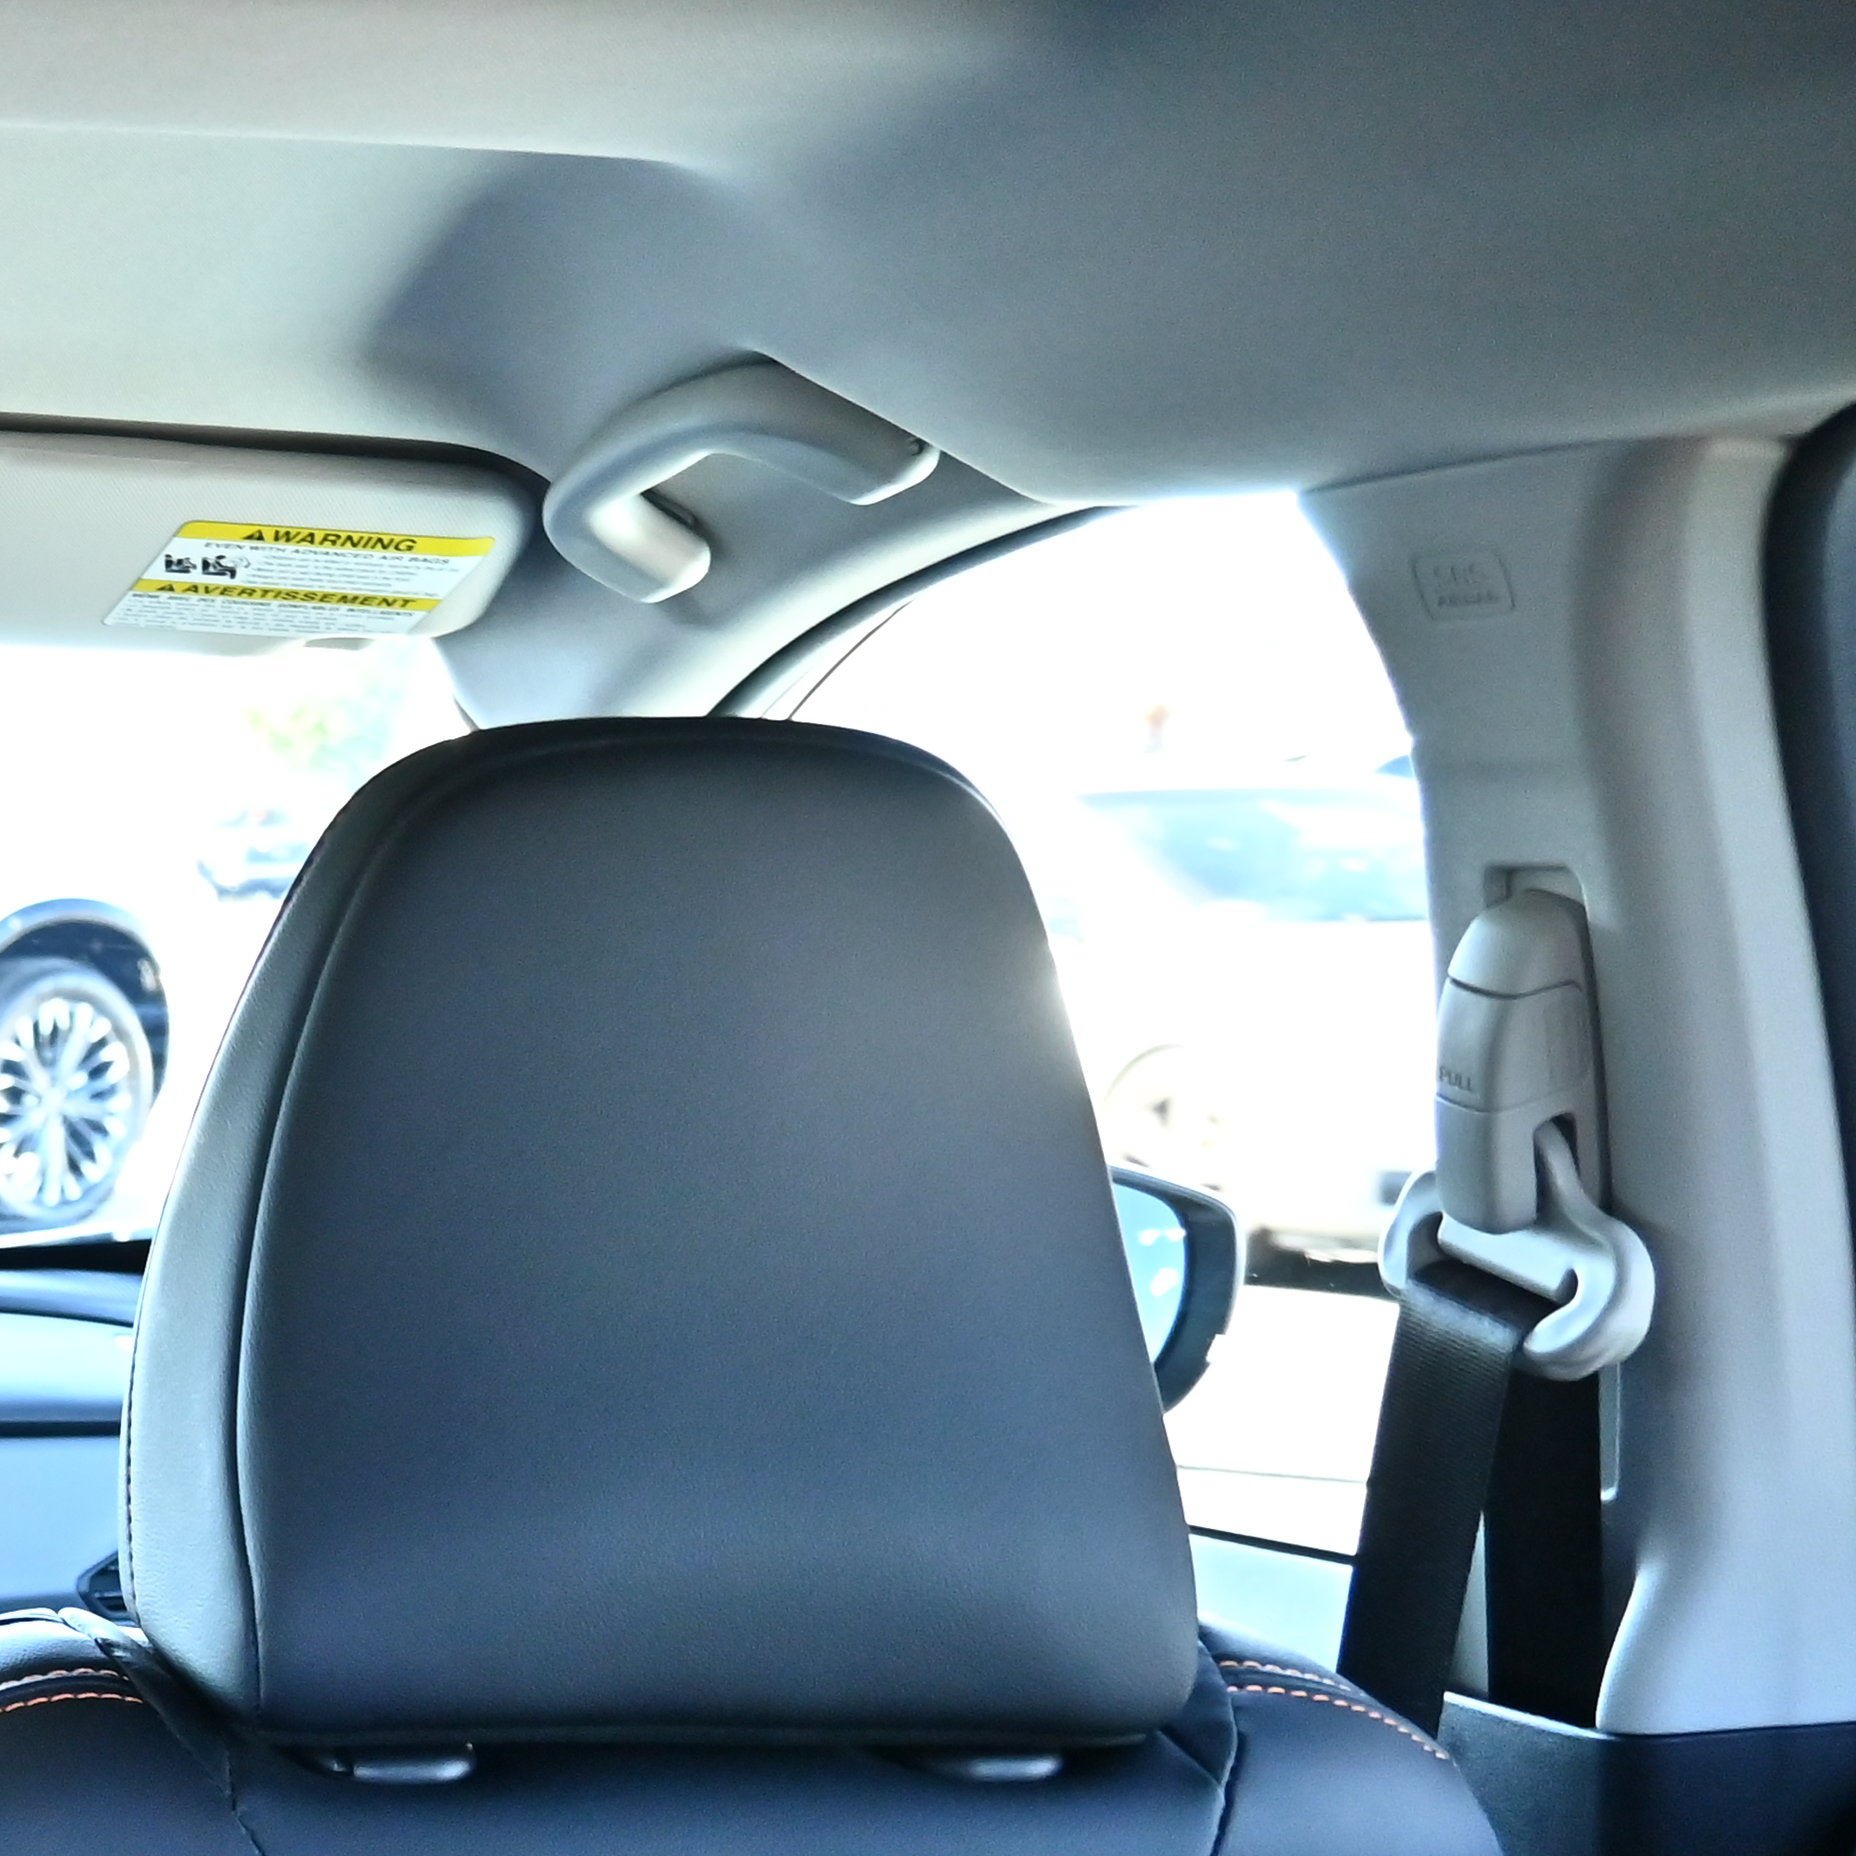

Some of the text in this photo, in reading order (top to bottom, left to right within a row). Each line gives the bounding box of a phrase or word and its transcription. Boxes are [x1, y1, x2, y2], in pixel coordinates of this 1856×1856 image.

[274, 529, 417, 552] WARNING
[181, 585, 416, 608] AVERTISSEMENT
[1439, 1066, 1474, 1092] PULL
